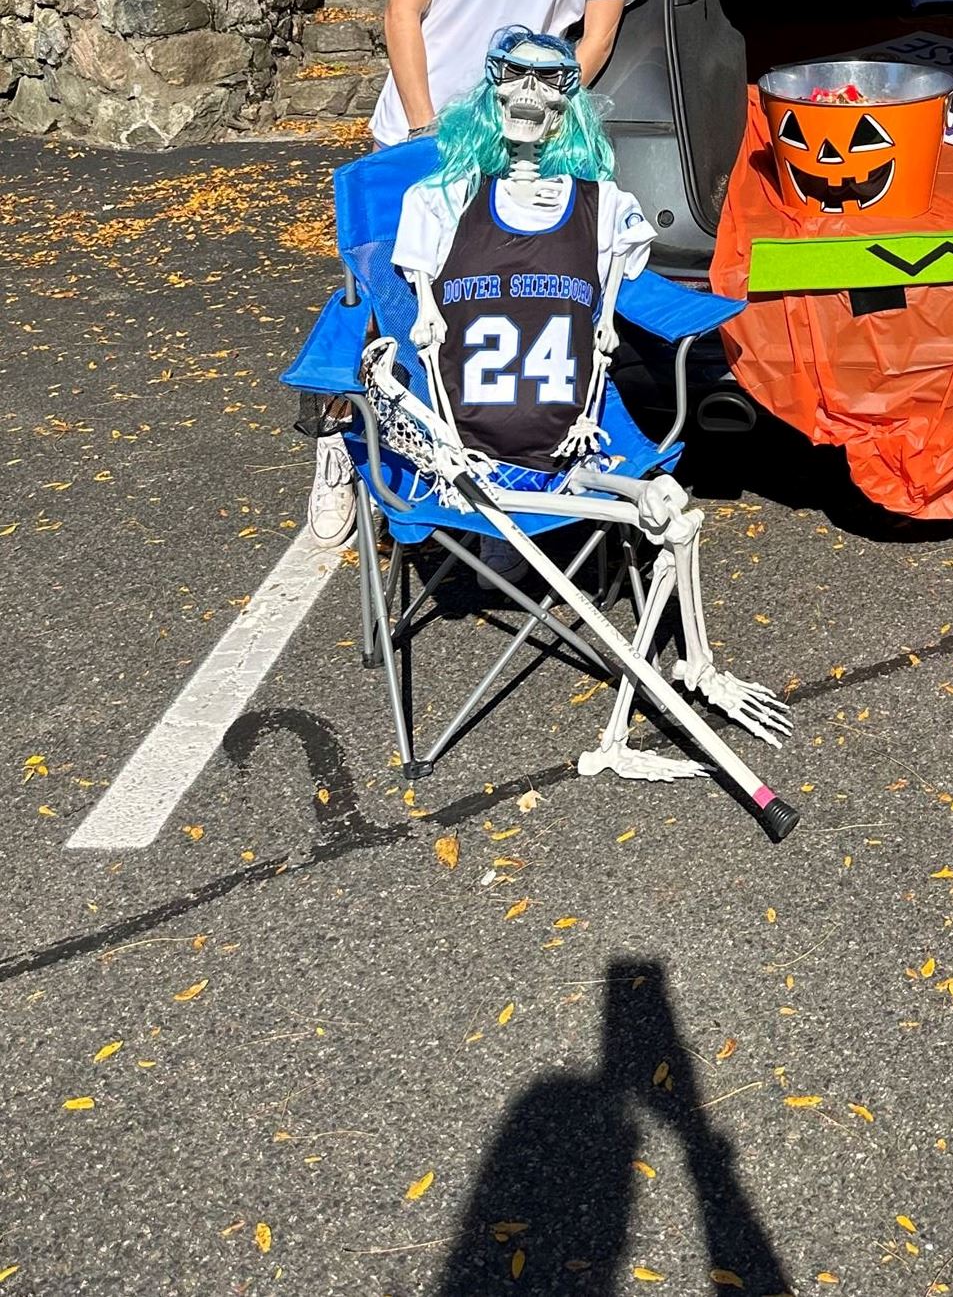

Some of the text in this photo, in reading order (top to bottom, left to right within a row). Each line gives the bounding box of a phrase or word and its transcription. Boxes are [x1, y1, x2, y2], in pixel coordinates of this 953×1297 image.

[443, 274, 593, 307] DOVER SHERBORN
[461, 314, 577, 406] 24
